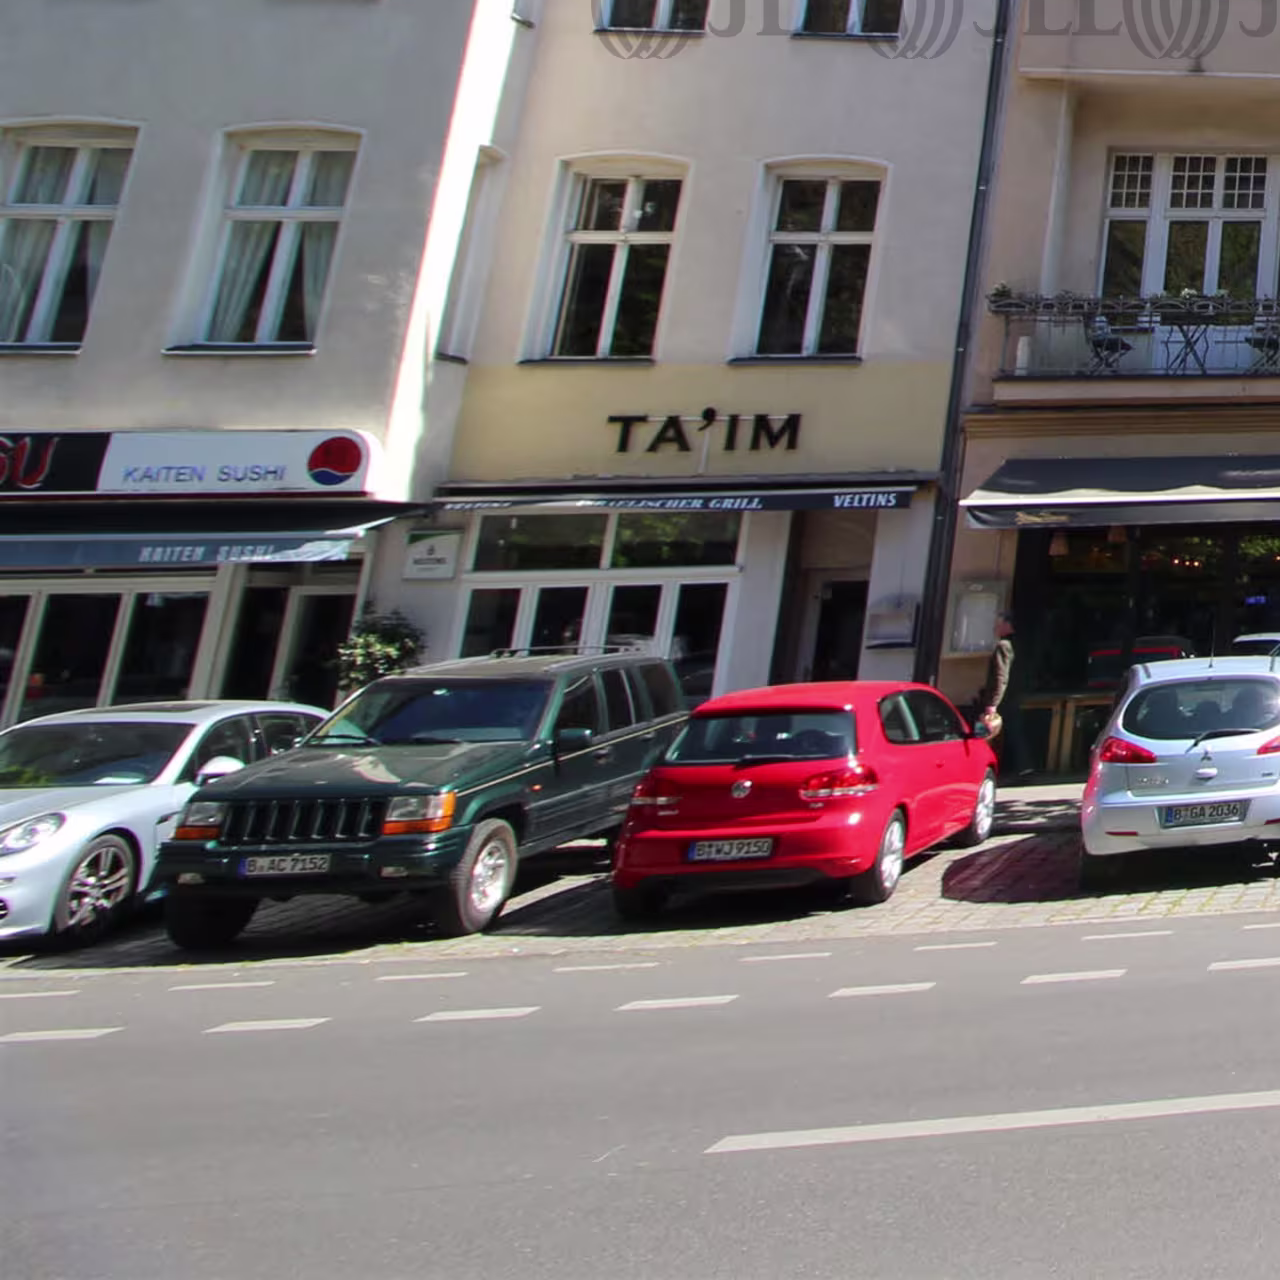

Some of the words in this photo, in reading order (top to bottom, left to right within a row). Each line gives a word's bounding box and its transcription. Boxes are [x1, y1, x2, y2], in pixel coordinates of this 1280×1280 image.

[122, 466, 207, 483] KAITEN
[217, 464, 286, 482] SUSHI
[708, 497, 764, 509] GRILL
[832, 492, 898, 508] VELTINS
[138, 546, 206, 563] KAITEN
[1190, 806, 1206, 819] GA
[1209, 803, 1239, 817] 2036
[267, 858, 288, 872] AC
[290, 856, 328, 872] 7152
